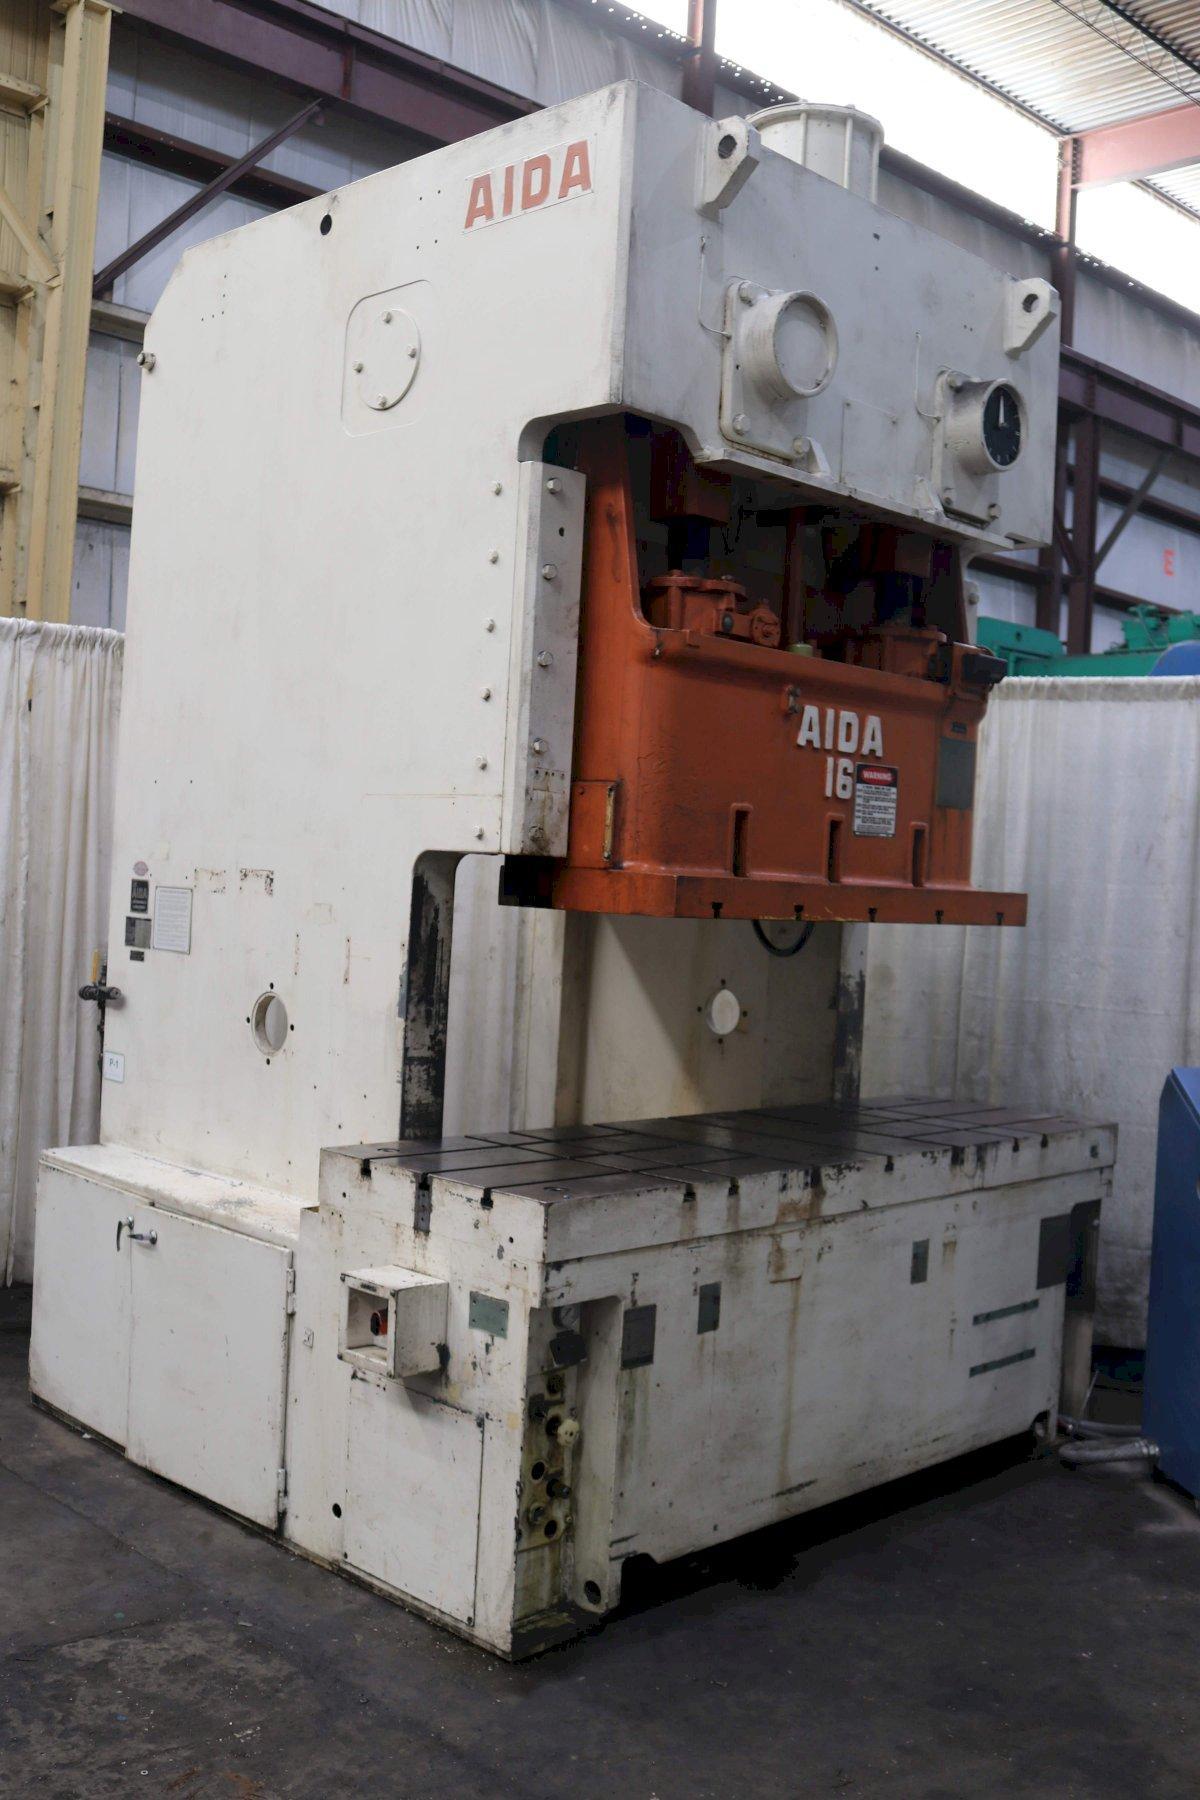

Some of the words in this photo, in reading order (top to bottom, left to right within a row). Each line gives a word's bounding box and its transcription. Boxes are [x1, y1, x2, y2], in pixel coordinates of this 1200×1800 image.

[465, 139, 592, 229] AIDA
[797, 705, 883, 757] AIDA
[825, 756, 854, 800] 16
[862, 770, 893, 781] WARNING
